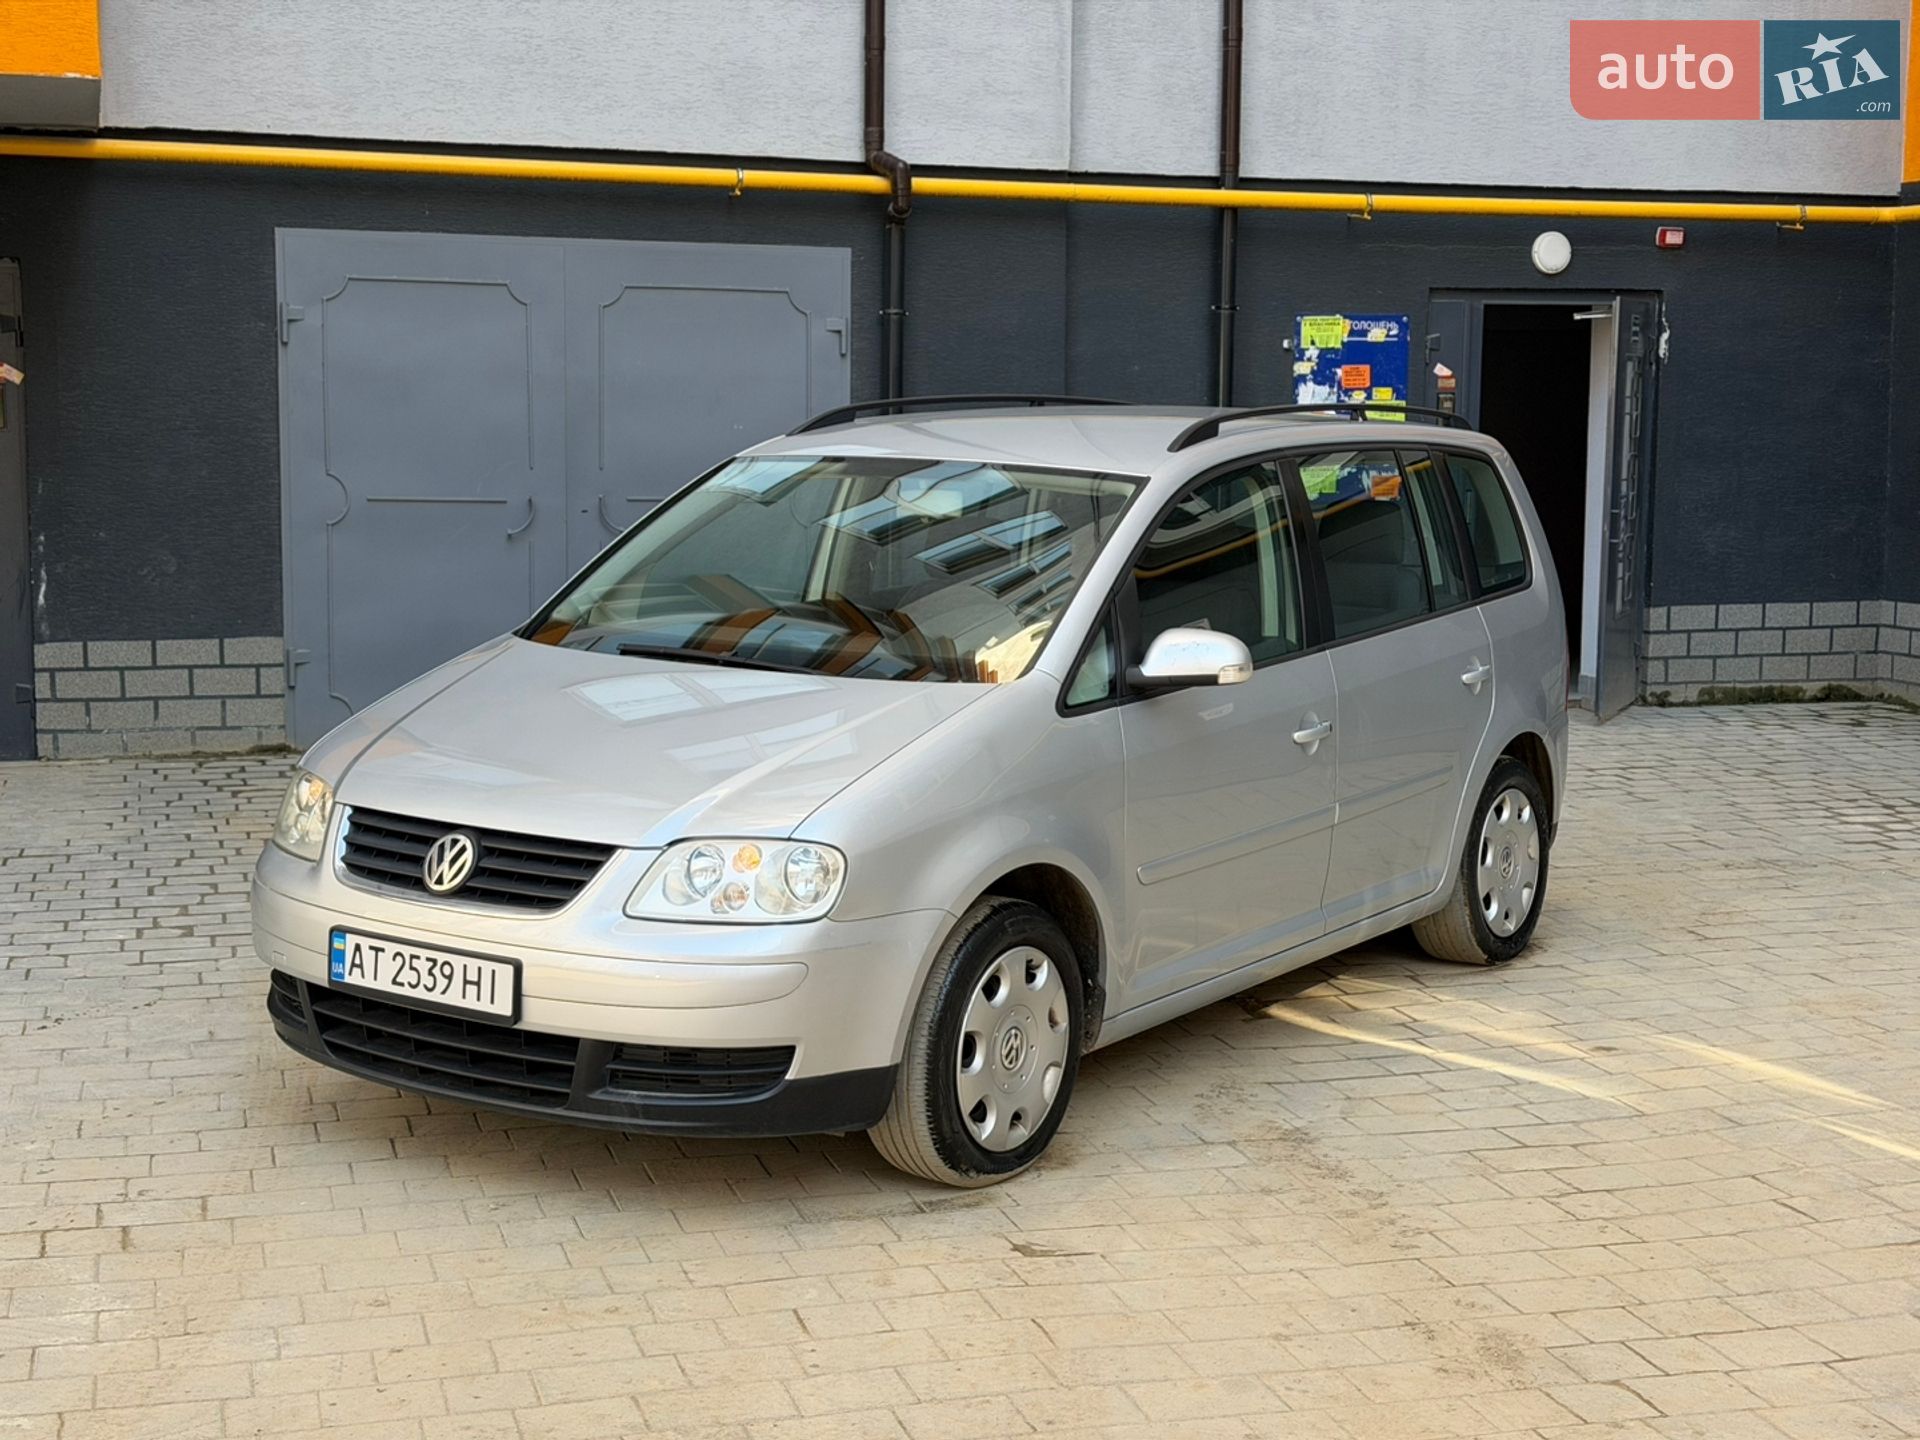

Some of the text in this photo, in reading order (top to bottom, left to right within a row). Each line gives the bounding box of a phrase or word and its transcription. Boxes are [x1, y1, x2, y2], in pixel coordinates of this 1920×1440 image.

[331, 961, 344, 975] UA
[348, 942, 496, 1005] AT 2539 HI
